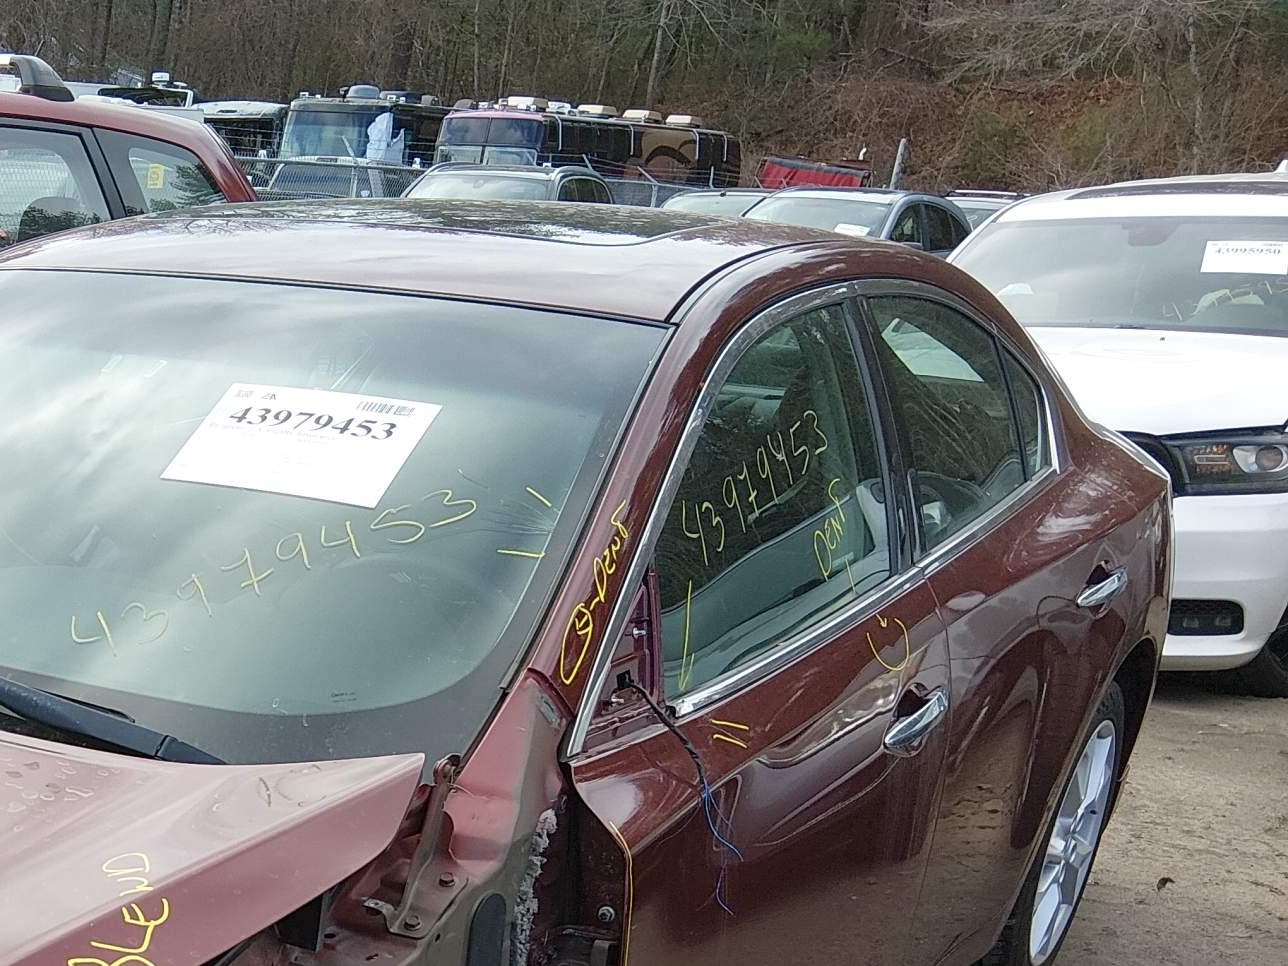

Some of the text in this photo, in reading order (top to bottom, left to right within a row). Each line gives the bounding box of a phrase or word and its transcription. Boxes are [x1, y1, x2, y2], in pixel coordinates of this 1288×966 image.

[228, 405, 399, 441] 43979453
[681, 410, 829, 566] 43979453
[70, 489, 478, 653] 43979453
